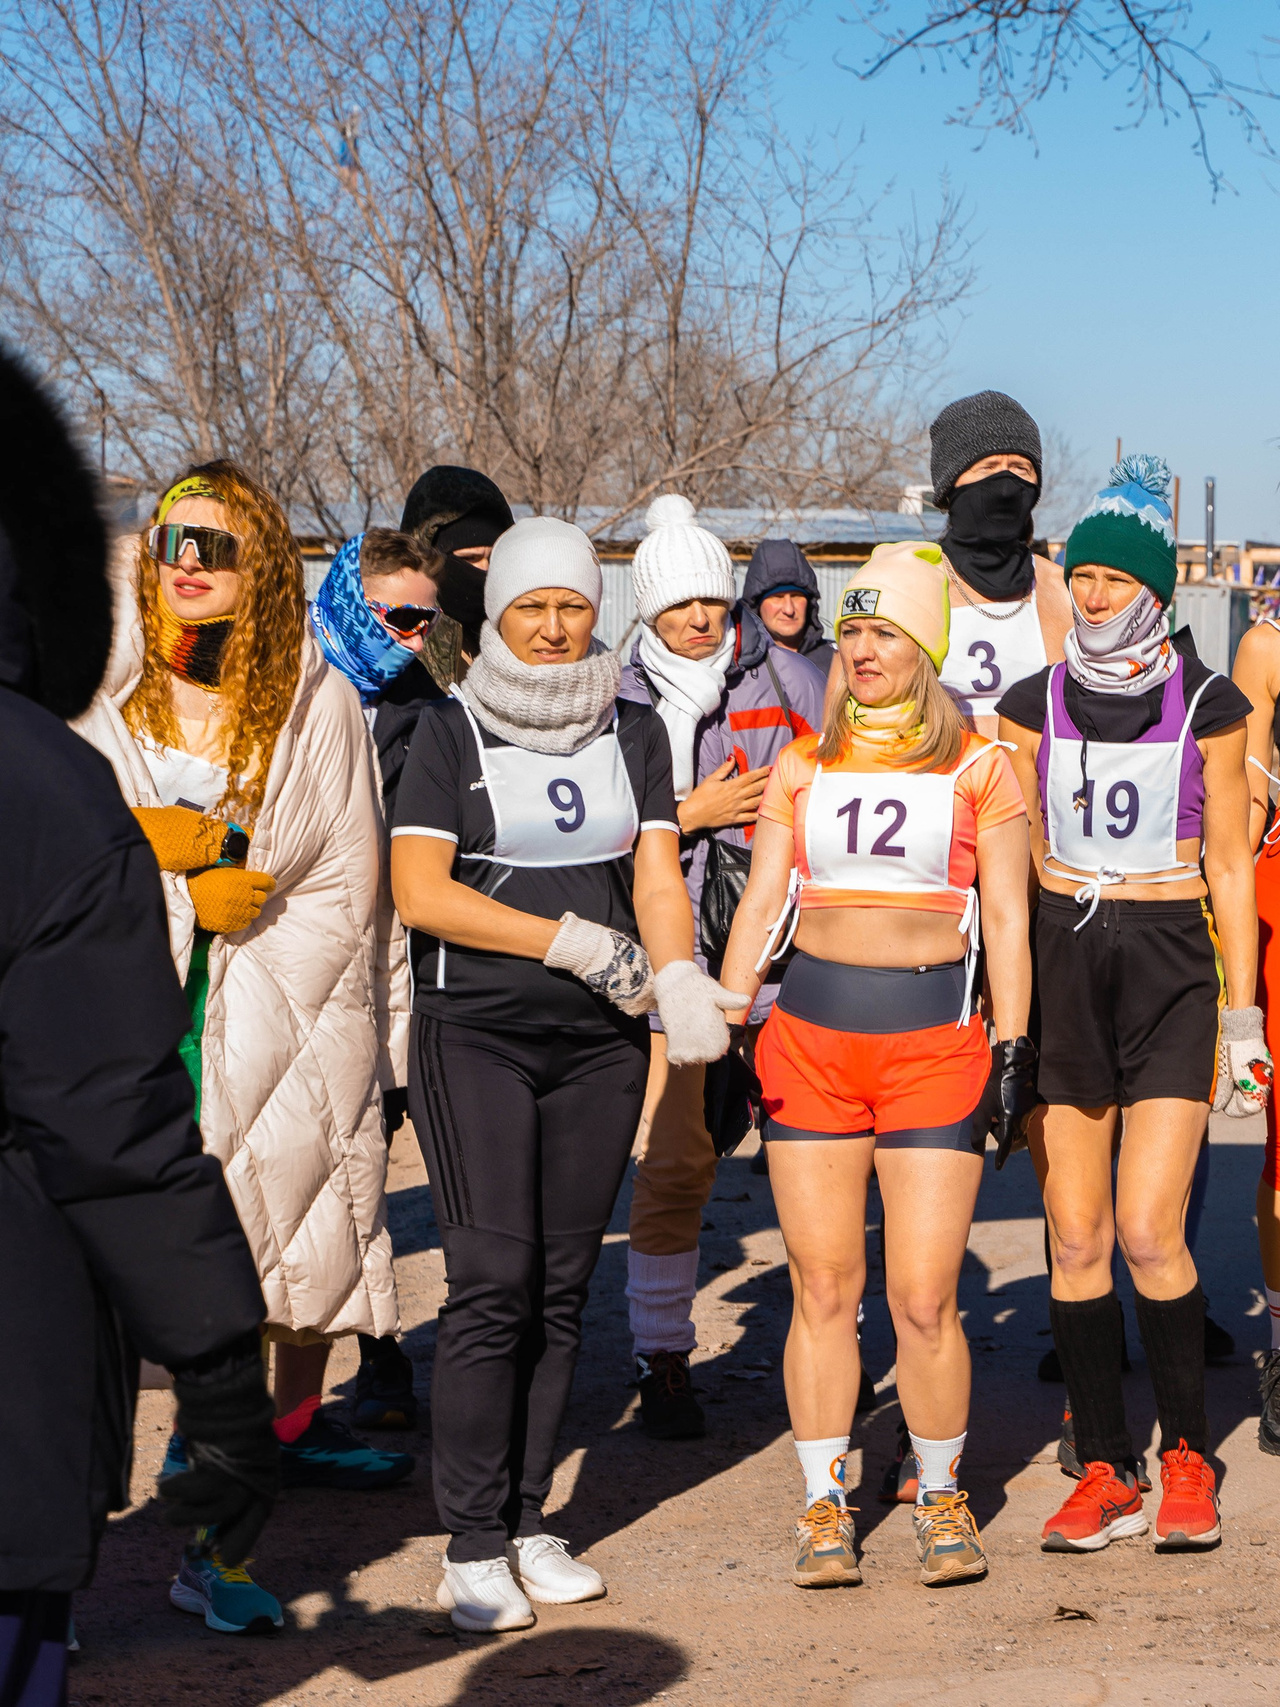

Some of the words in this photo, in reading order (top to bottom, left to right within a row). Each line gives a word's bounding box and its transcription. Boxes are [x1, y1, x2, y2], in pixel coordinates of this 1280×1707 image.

[967, 640, 1001, 692] 3
[547, 778, 585, 833] 9
[836, 797, 907, 858] 12
[1072, 779, 1140, 839] 19
